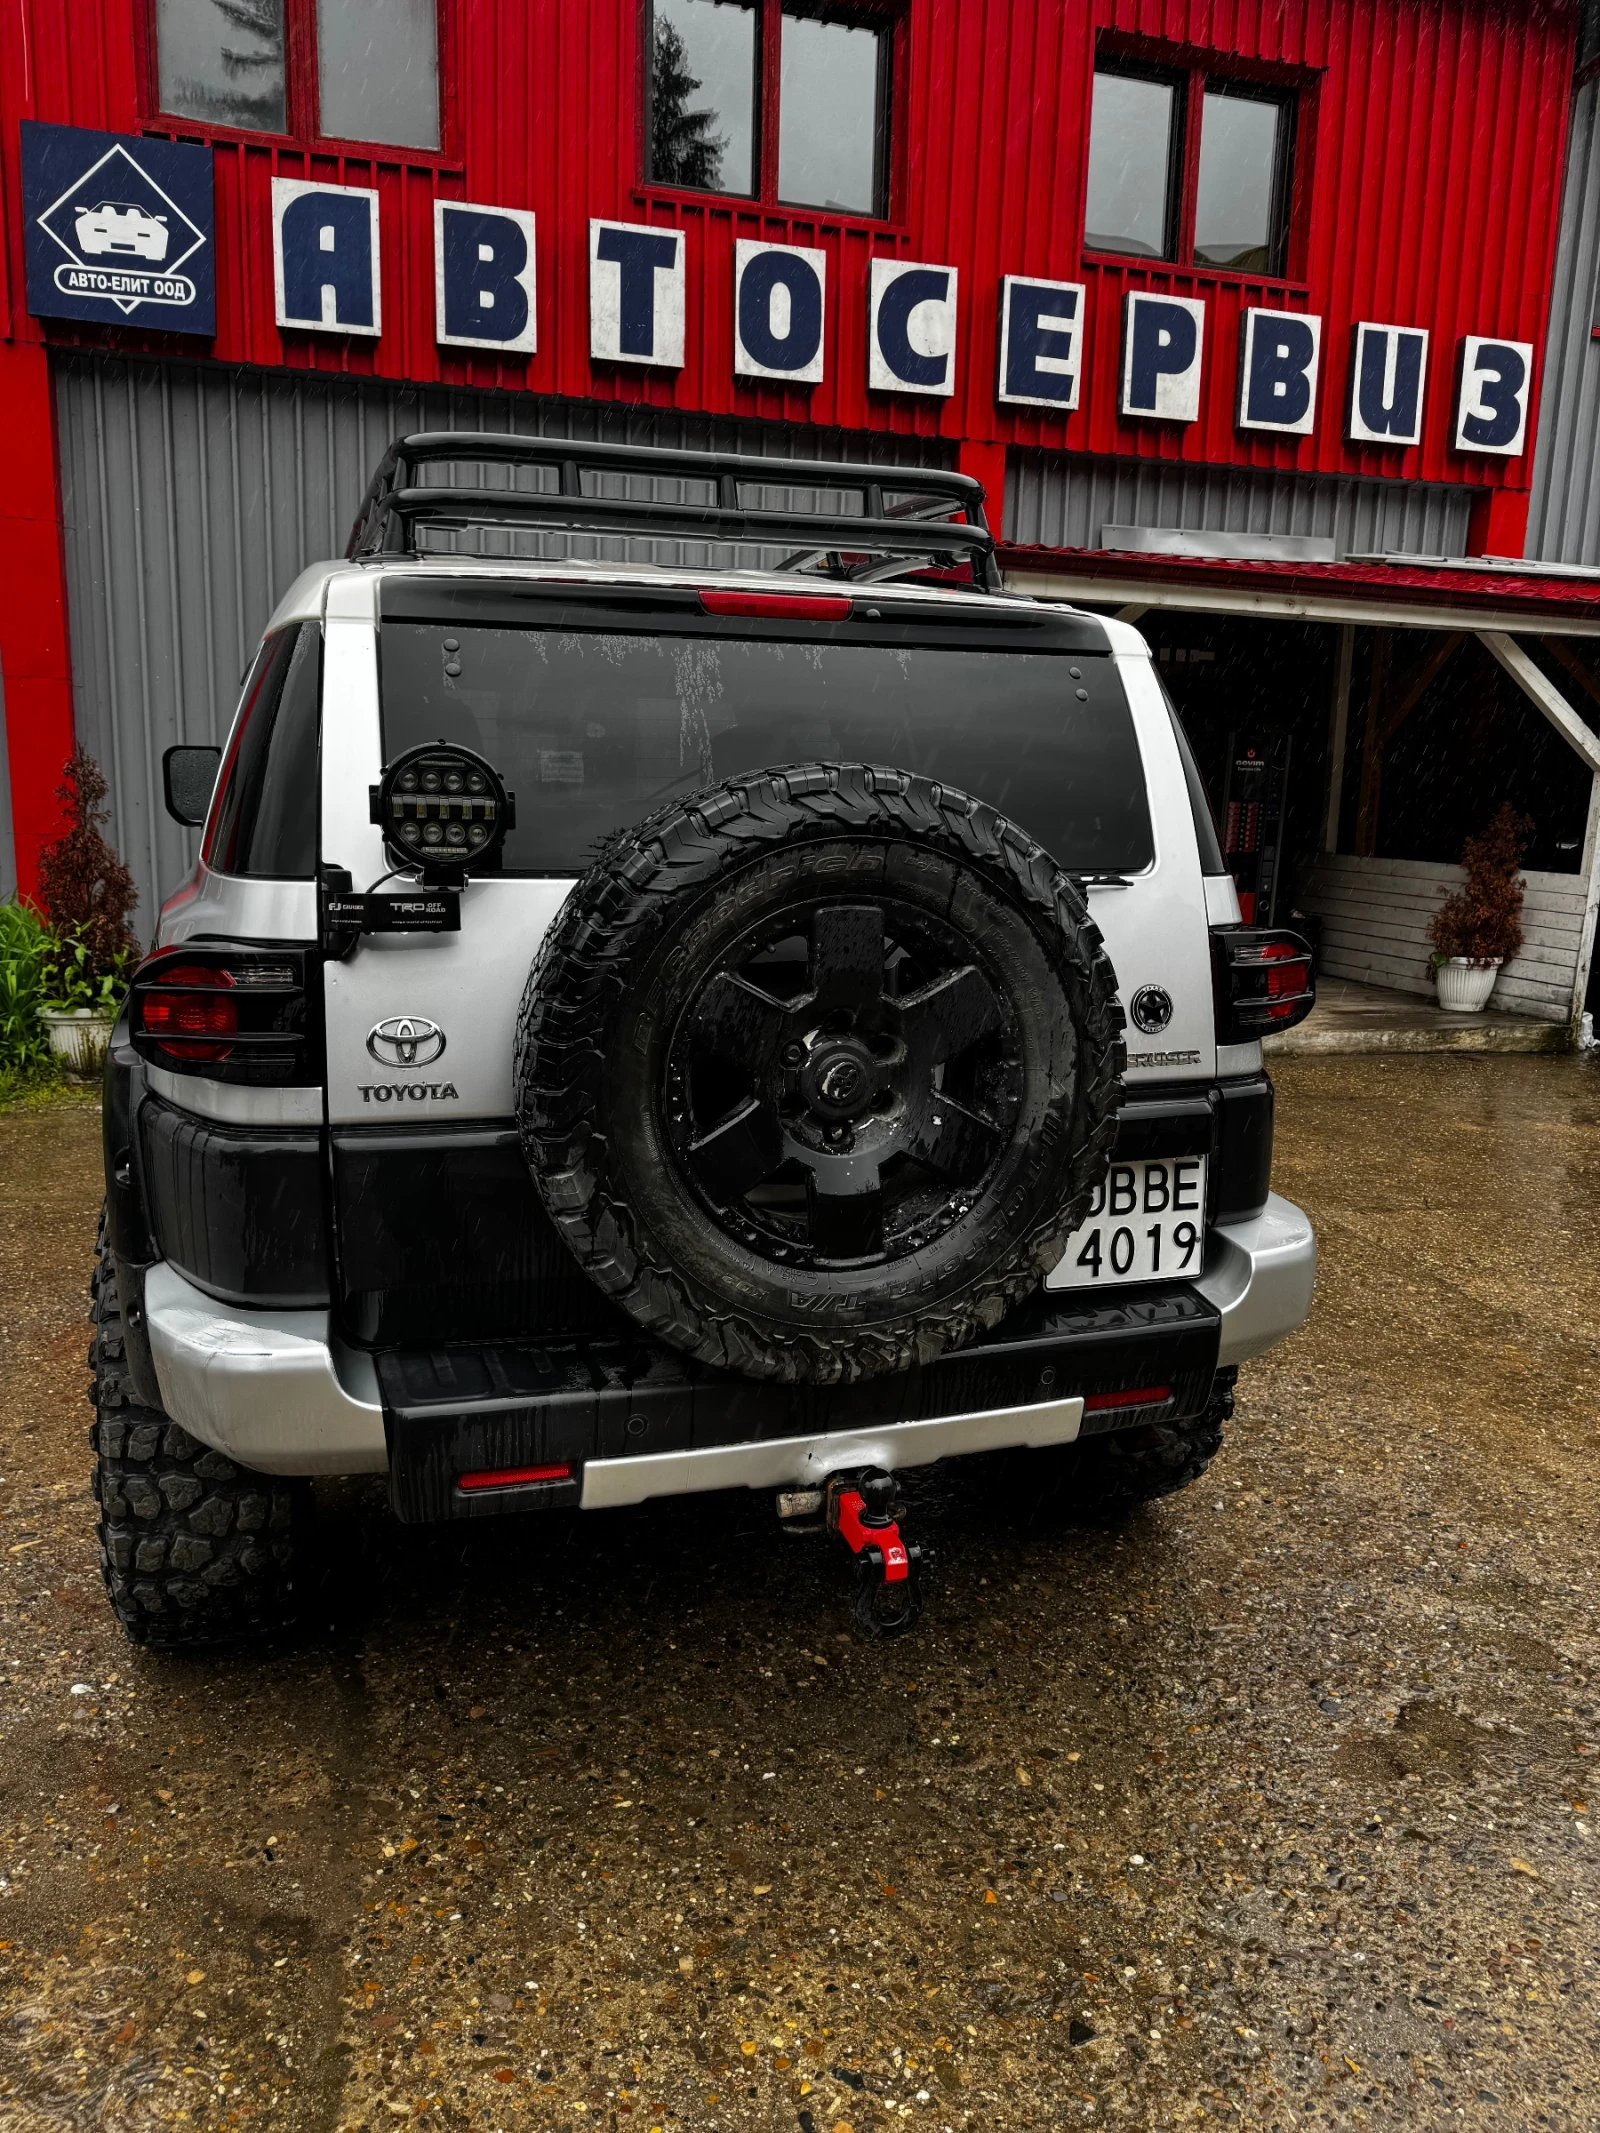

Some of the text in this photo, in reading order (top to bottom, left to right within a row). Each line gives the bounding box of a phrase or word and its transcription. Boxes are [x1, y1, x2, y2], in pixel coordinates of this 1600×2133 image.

[68, 271, 186, 300] АВТО-ЕЛИТ ООД
[328, 902, 342, 911] FJ
[389, 902, 425, 913] TRD
[357, 1081, 459, 1102] TOYOTA
[1076, 1220, 1197, 1277] 4019
